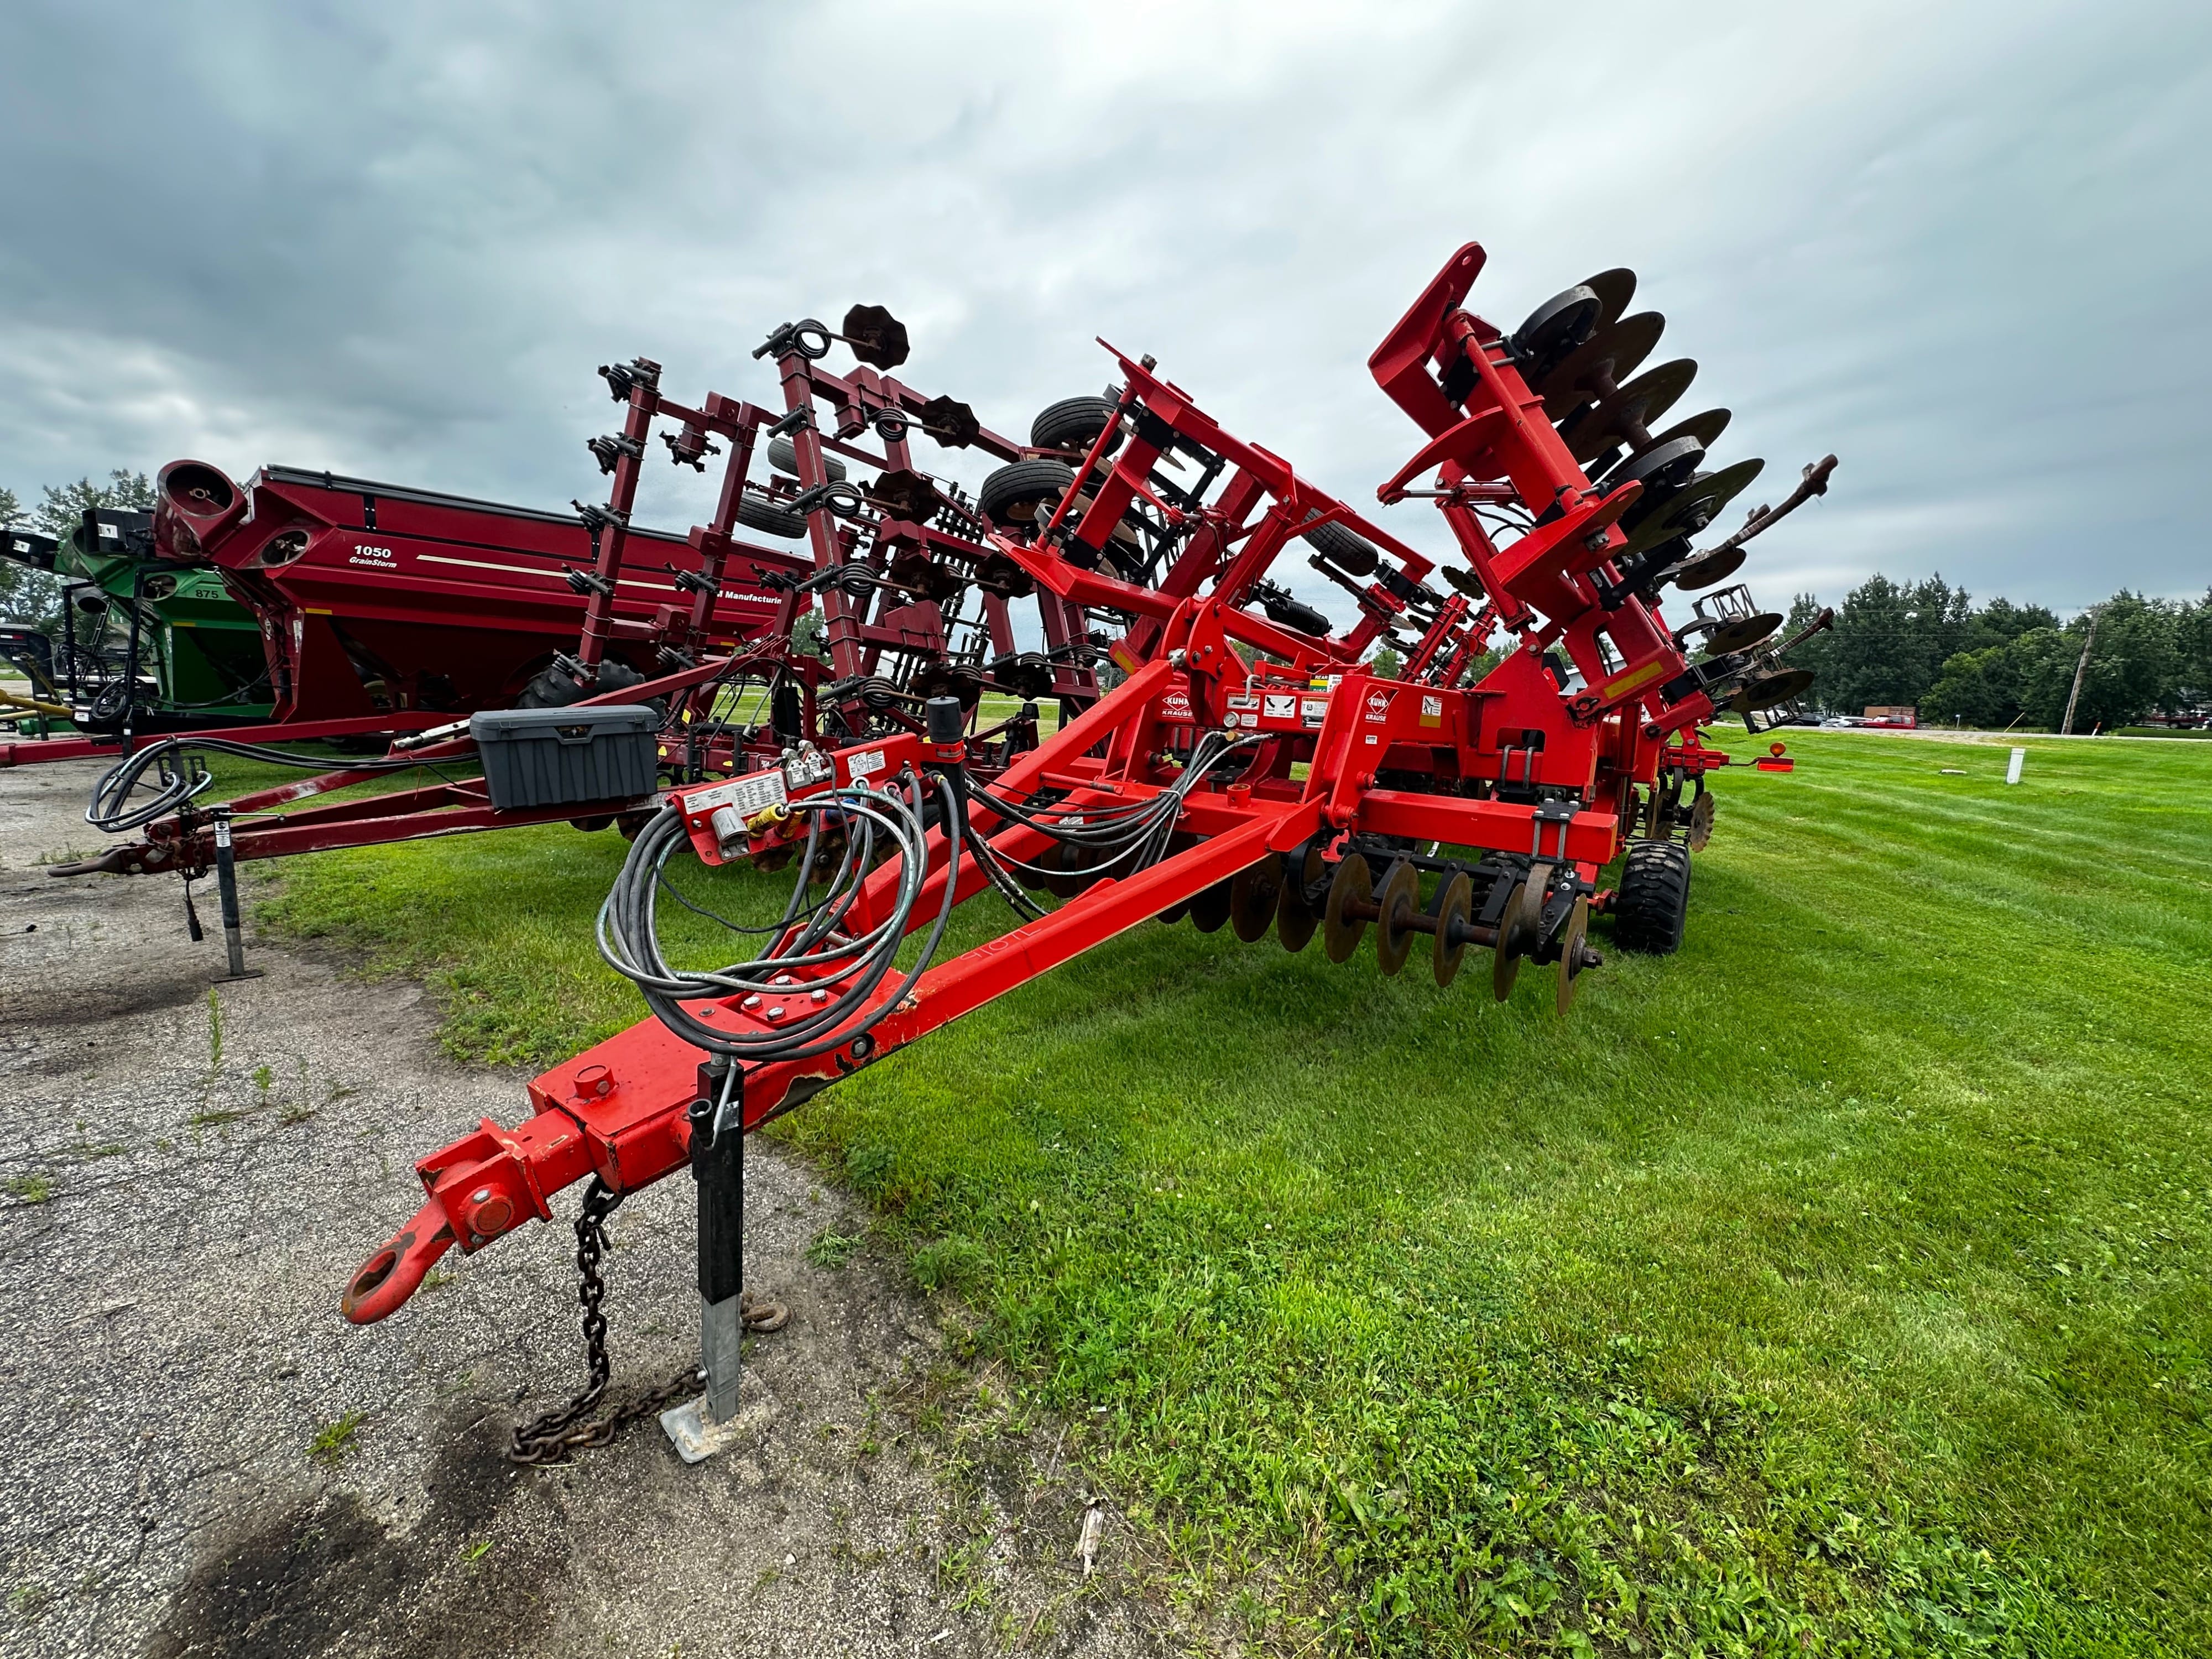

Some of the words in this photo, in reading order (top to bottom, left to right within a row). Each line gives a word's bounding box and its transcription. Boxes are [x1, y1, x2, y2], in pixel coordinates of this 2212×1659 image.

[354, 545, 392, 558] 1050
[349, 556, 398, 568] GrainStorm
[196, 589, 218, 598] 875
[725, 591, 782, 604] Manufacturin
[1370, 697, 1386, 707] KUHN
